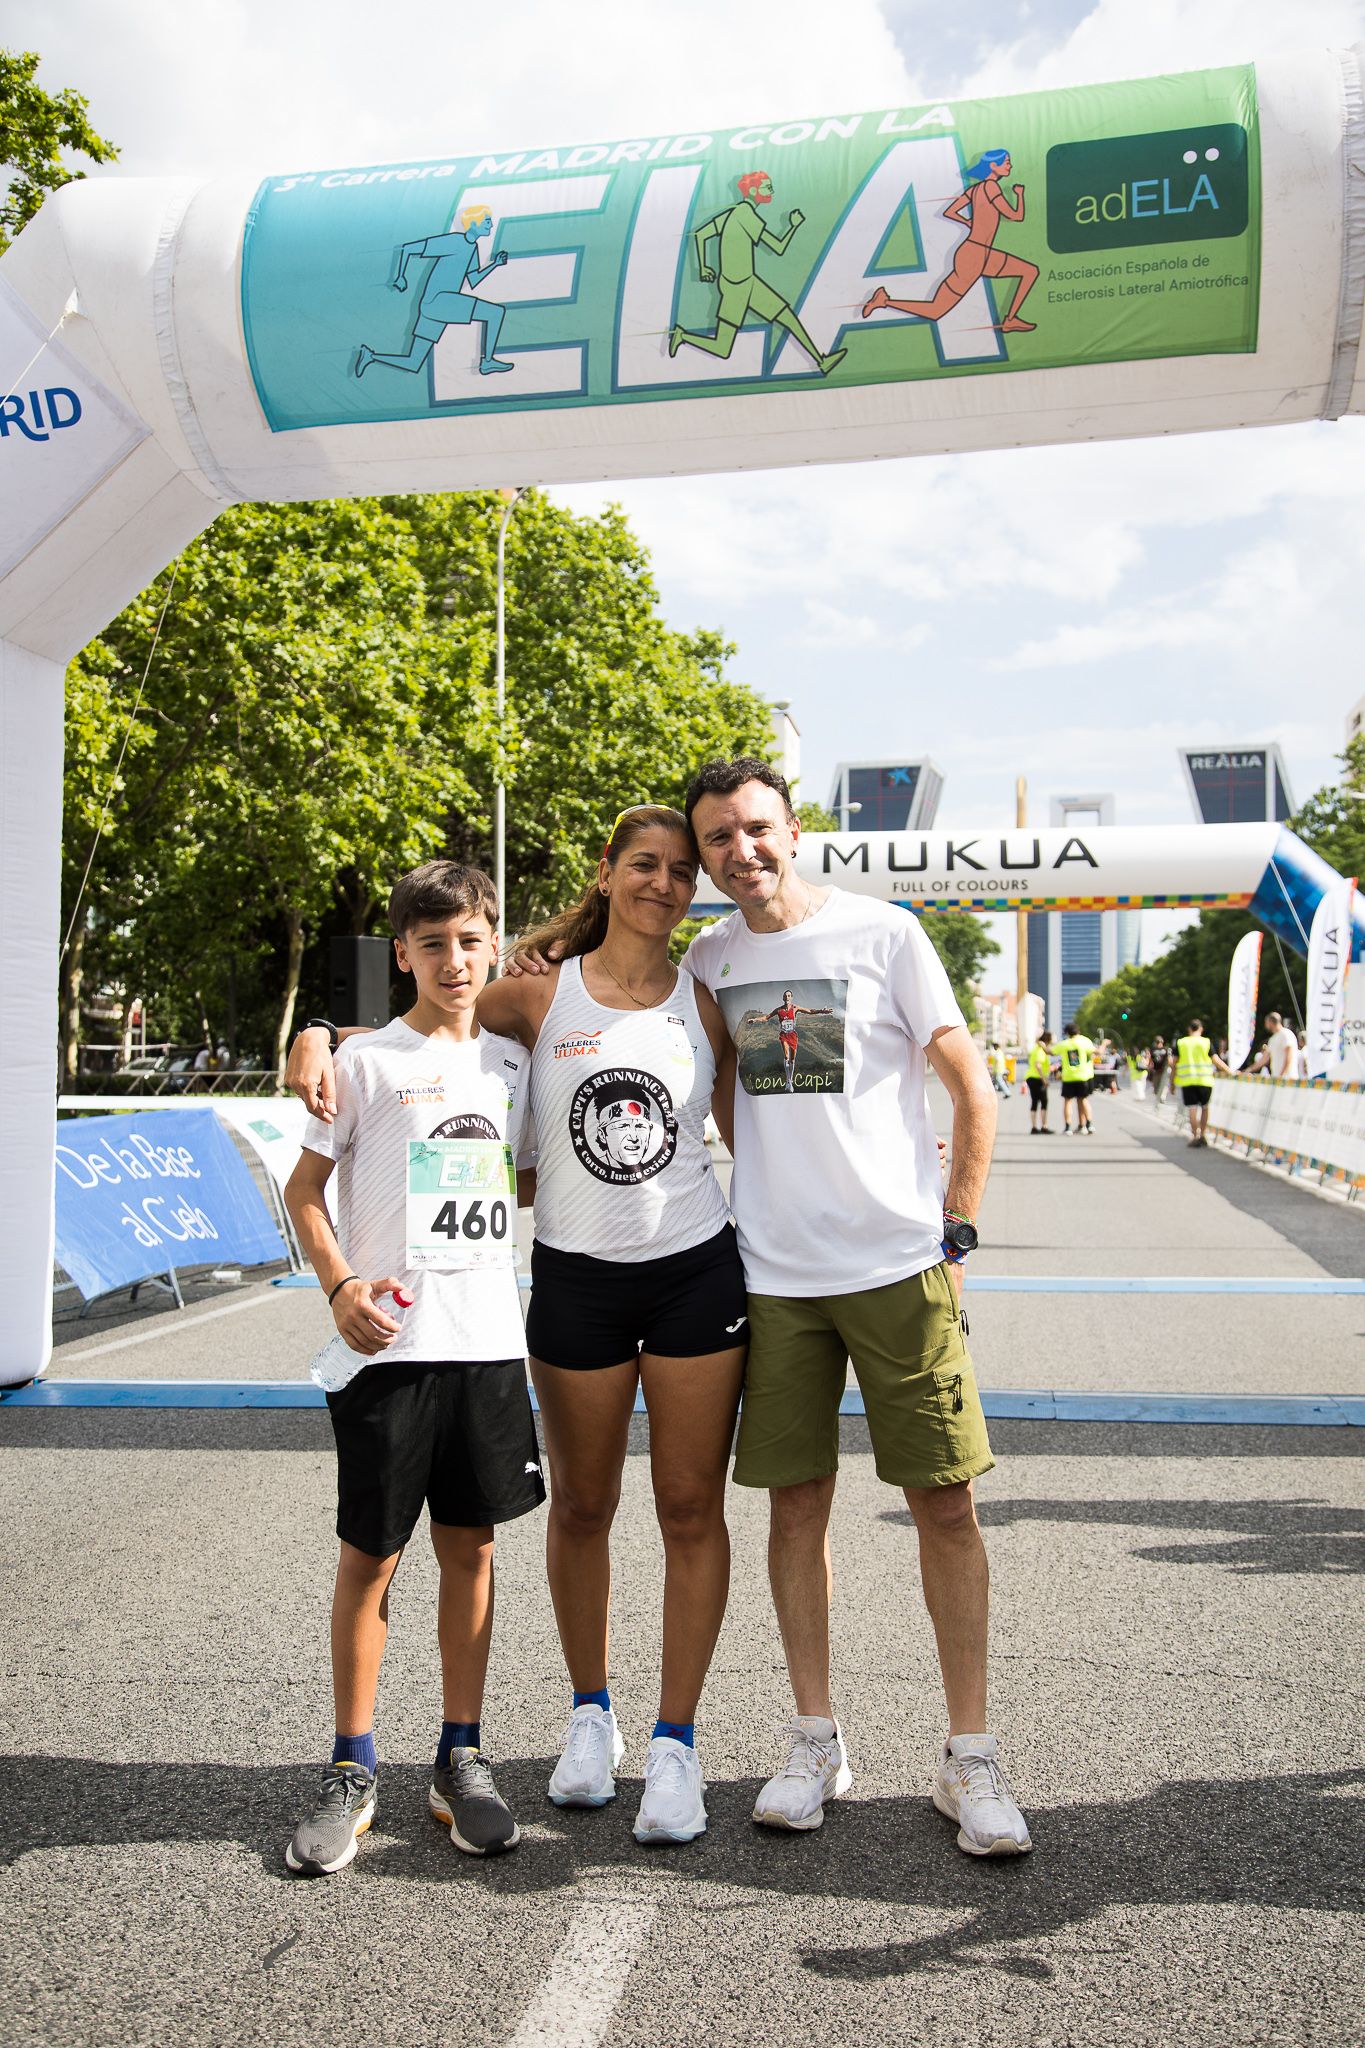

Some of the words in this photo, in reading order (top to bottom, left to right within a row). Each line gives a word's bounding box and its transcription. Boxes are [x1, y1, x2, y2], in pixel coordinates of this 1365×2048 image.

[321, 164, 457, 188] Carrera
[471, 135, 711, 179] MADRID
[728, 117, 863, 151] CON
[875, 105, 956, 134] LA
[430, 130, 1008, 405] ELA
[1047, 264, 1122, 282] Asociación
[1126, 255, 1188, 275] Española
[1192, 255, 1210, 267] de
[1047, 286, 1115, 303] Esclerosis
[1118, 280, 1165, 296] Lateral
[1169, 273, 1249, 292] Amiotrófica
[823, 838, 1099, 873] MUKUA
[893, 881, 925, 892] FULL
[932, 881, 951, 891] OF
[956, 879, 1029, 891] COLOURS
[1320, 927, 1340, 1052] MUKUA
[552, 1039, 602, 1054] TALLERES
[554, 1046, 600, 1059] JUMA
[755, 1077, 786, 1089] con
[572, 1085, 593, 1130] CAPI'S
[592, 1071, 661, 1093] RUNNING
[442, 1118, 496, 1140] RUNNING
[55, 1145, 122, 1189] De
[100, 1137, 151, 1180] la
[130, 1133, 201, 1180] Base
[581, 1150, 608, 1178] Corro,
[611, 1171, 643, 1182] luego
[643, 1148, 672, 1177] existo
[142, 1195, 219, 1242] Cielo
[431, 1200, 507, 1240] 460
